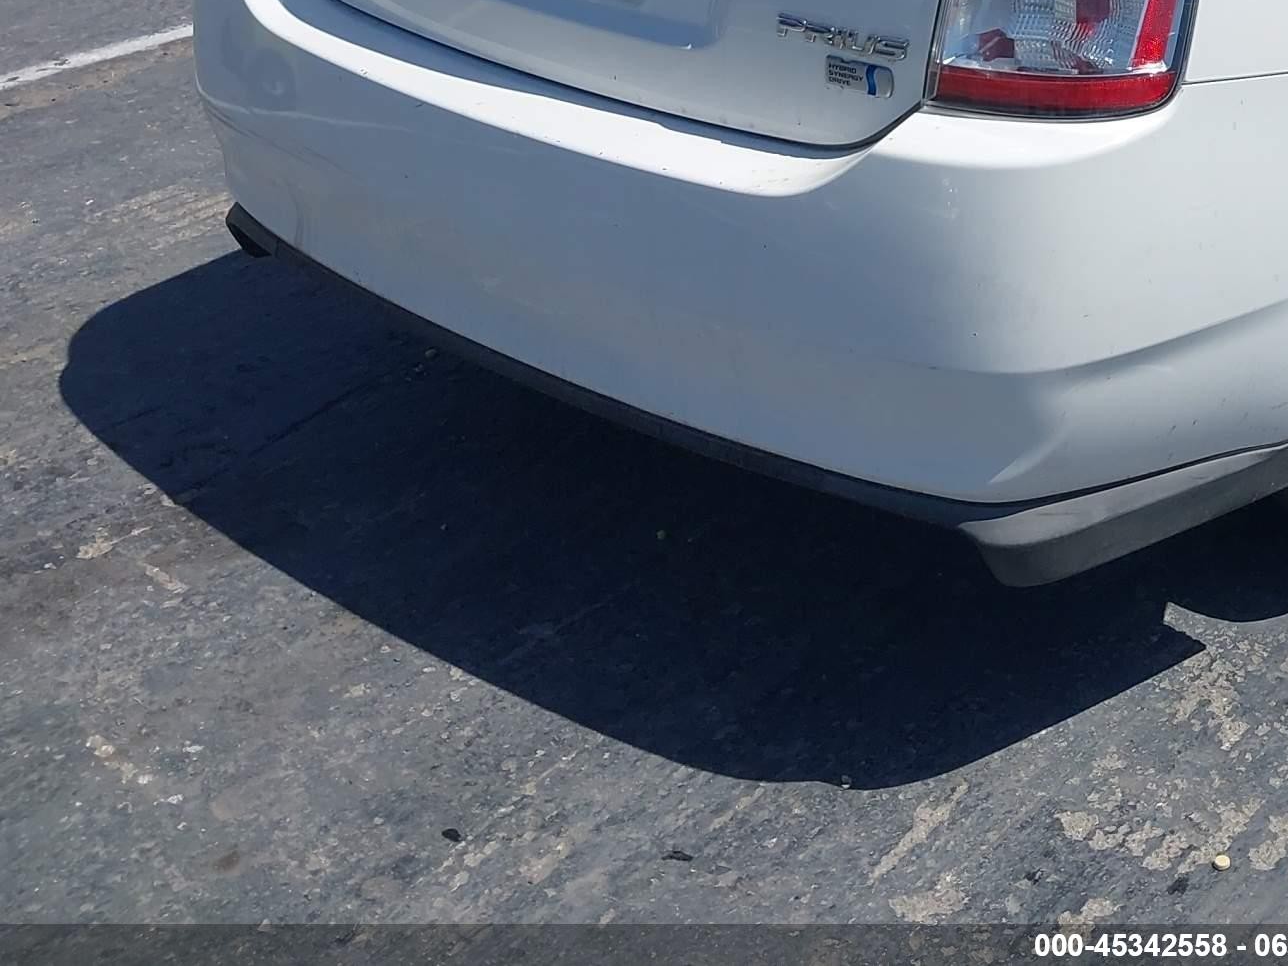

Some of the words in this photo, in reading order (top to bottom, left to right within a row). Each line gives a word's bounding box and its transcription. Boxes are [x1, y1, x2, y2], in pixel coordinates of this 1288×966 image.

[776, 12, 910, 62] PRIUS
[828, 62, 857, 75] HYBRID
[828, 69, 864, 83] SYNERGY
[828, 77, 852, 87] DRIVE
